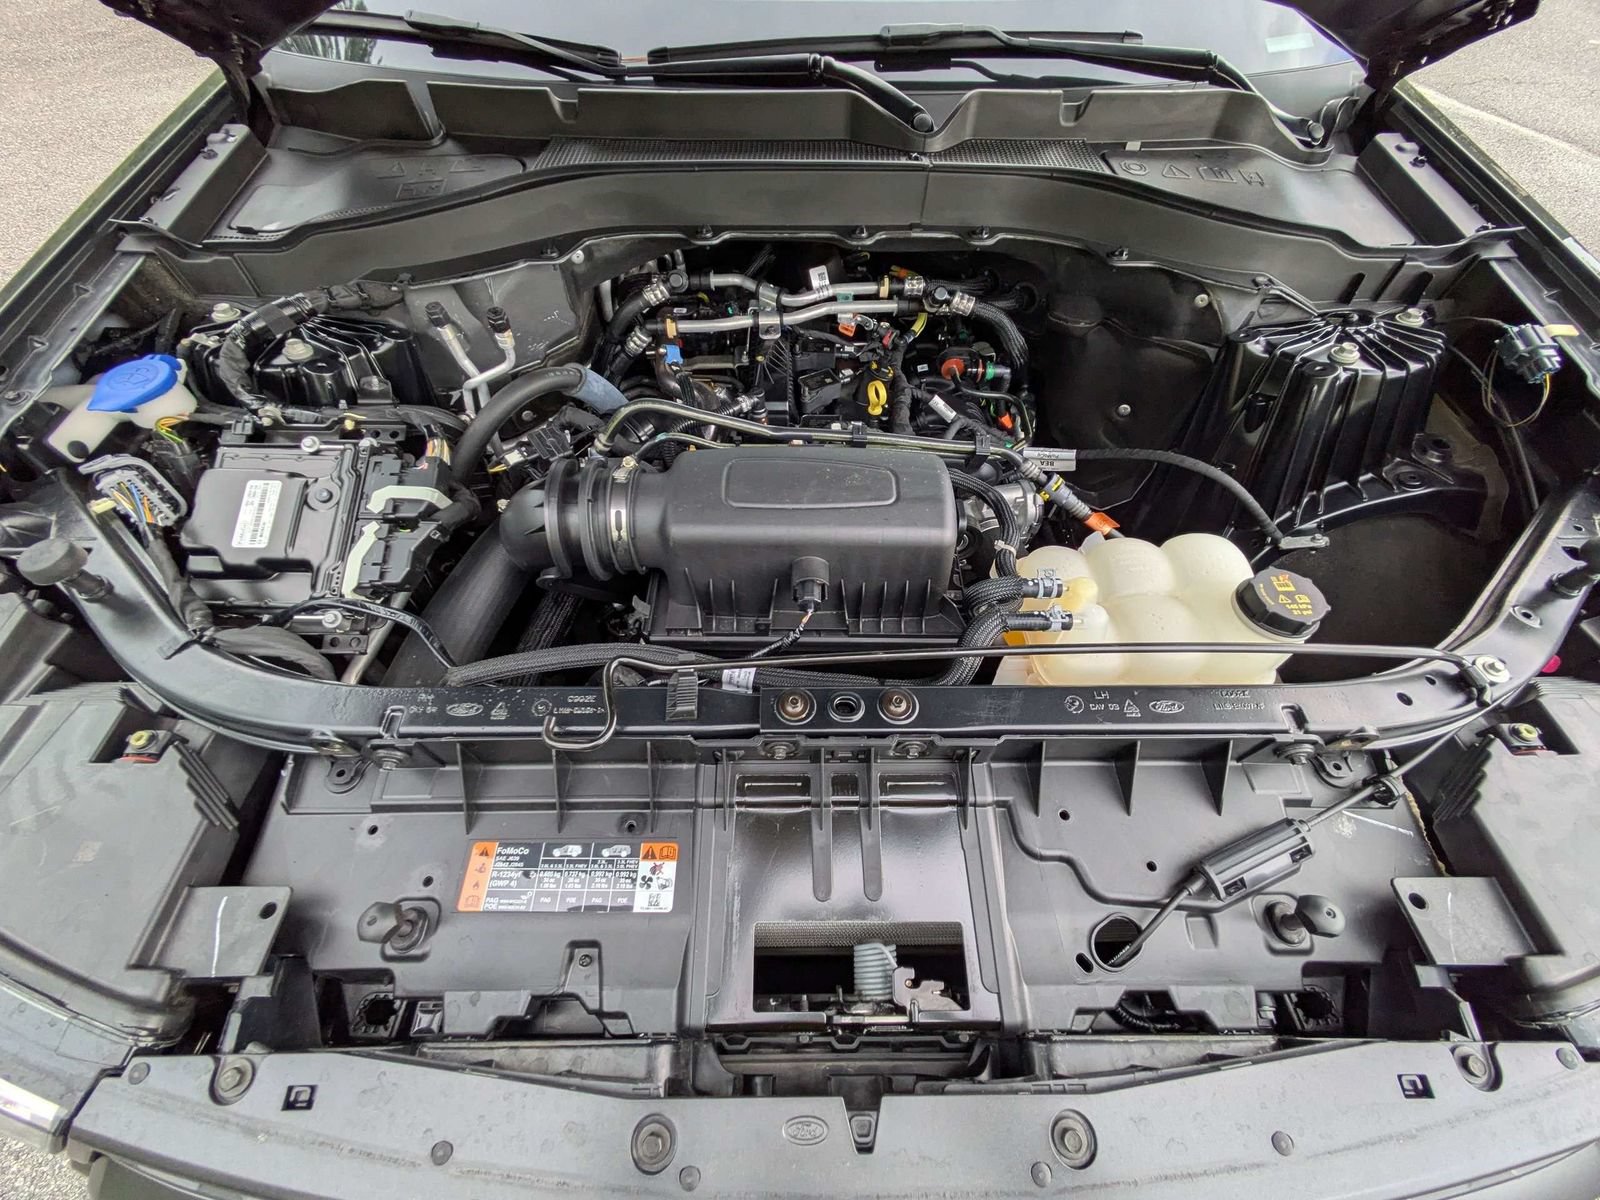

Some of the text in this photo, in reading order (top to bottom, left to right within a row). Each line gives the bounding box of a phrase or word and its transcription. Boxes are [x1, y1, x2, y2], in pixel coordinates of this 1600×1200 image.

[1094, 690, 1110, 700] LH
[496, 846, 530, 855] FoMoCo
[492, 871, 522, 879] R-1234yf
[490, 880, 517, 888] (GWP 4)
